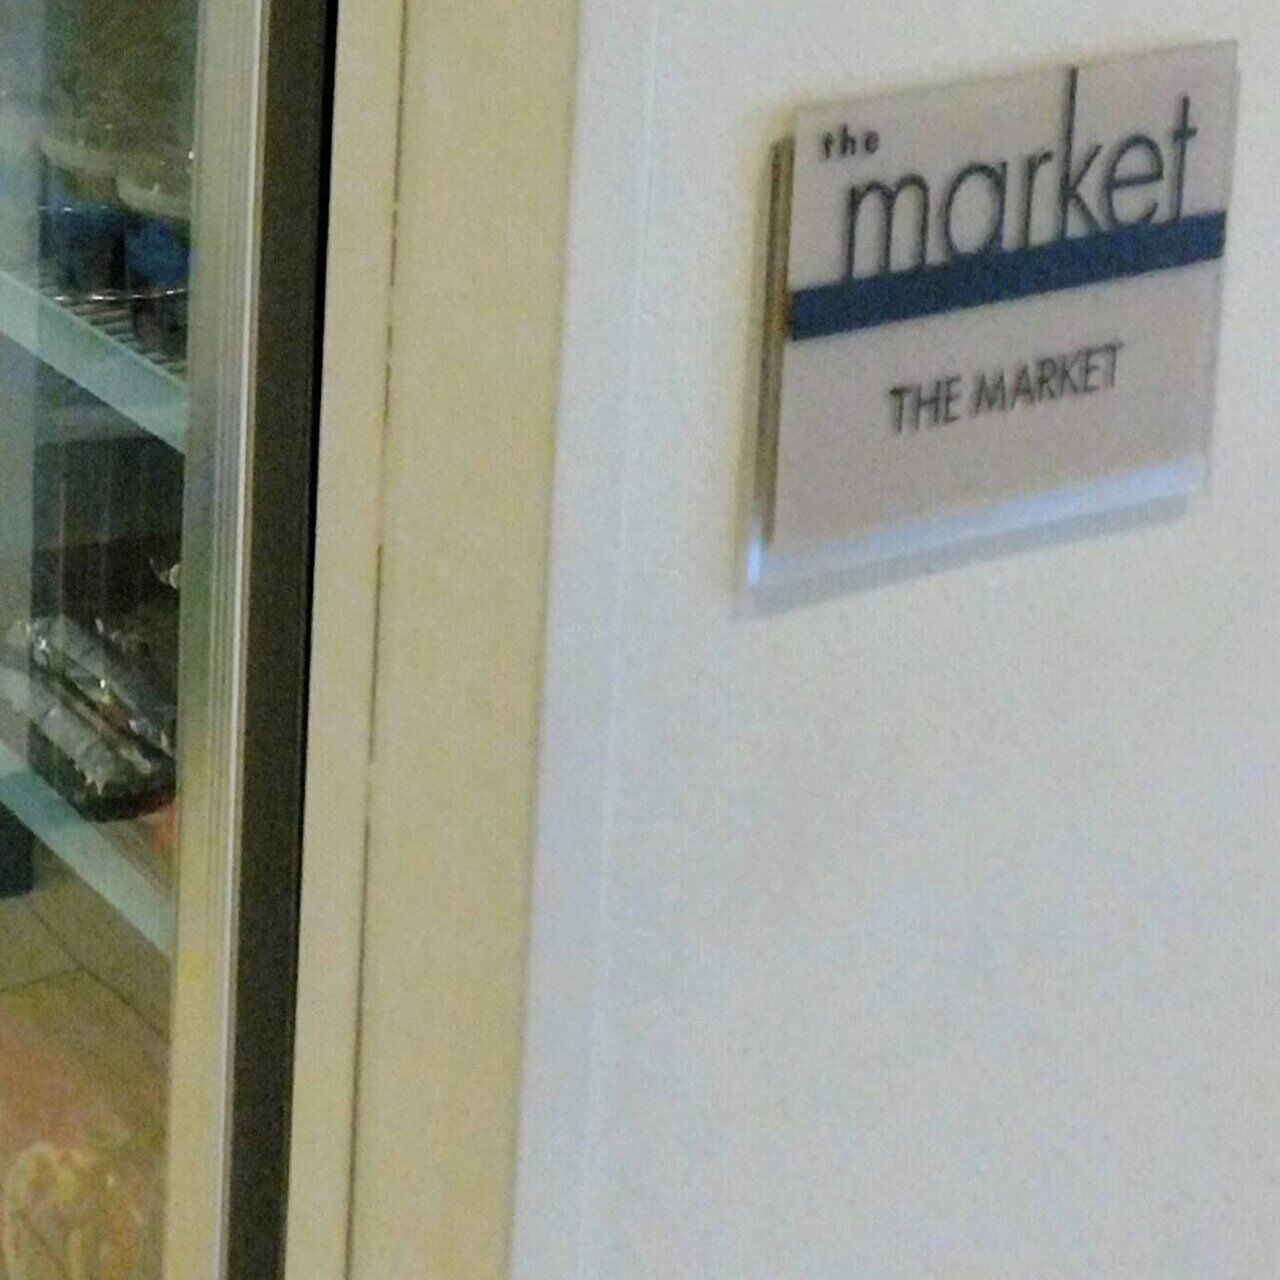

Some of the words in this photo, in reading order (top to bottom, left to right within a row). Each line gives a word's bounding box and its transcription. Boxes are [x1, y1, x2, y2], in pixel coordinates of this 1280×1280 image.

[818, 123, 881, 162] the
[844, 65, 1198, 280] market
[889, 376, 963, 436] THE
[973, 341, 1125, 419] MARKET
